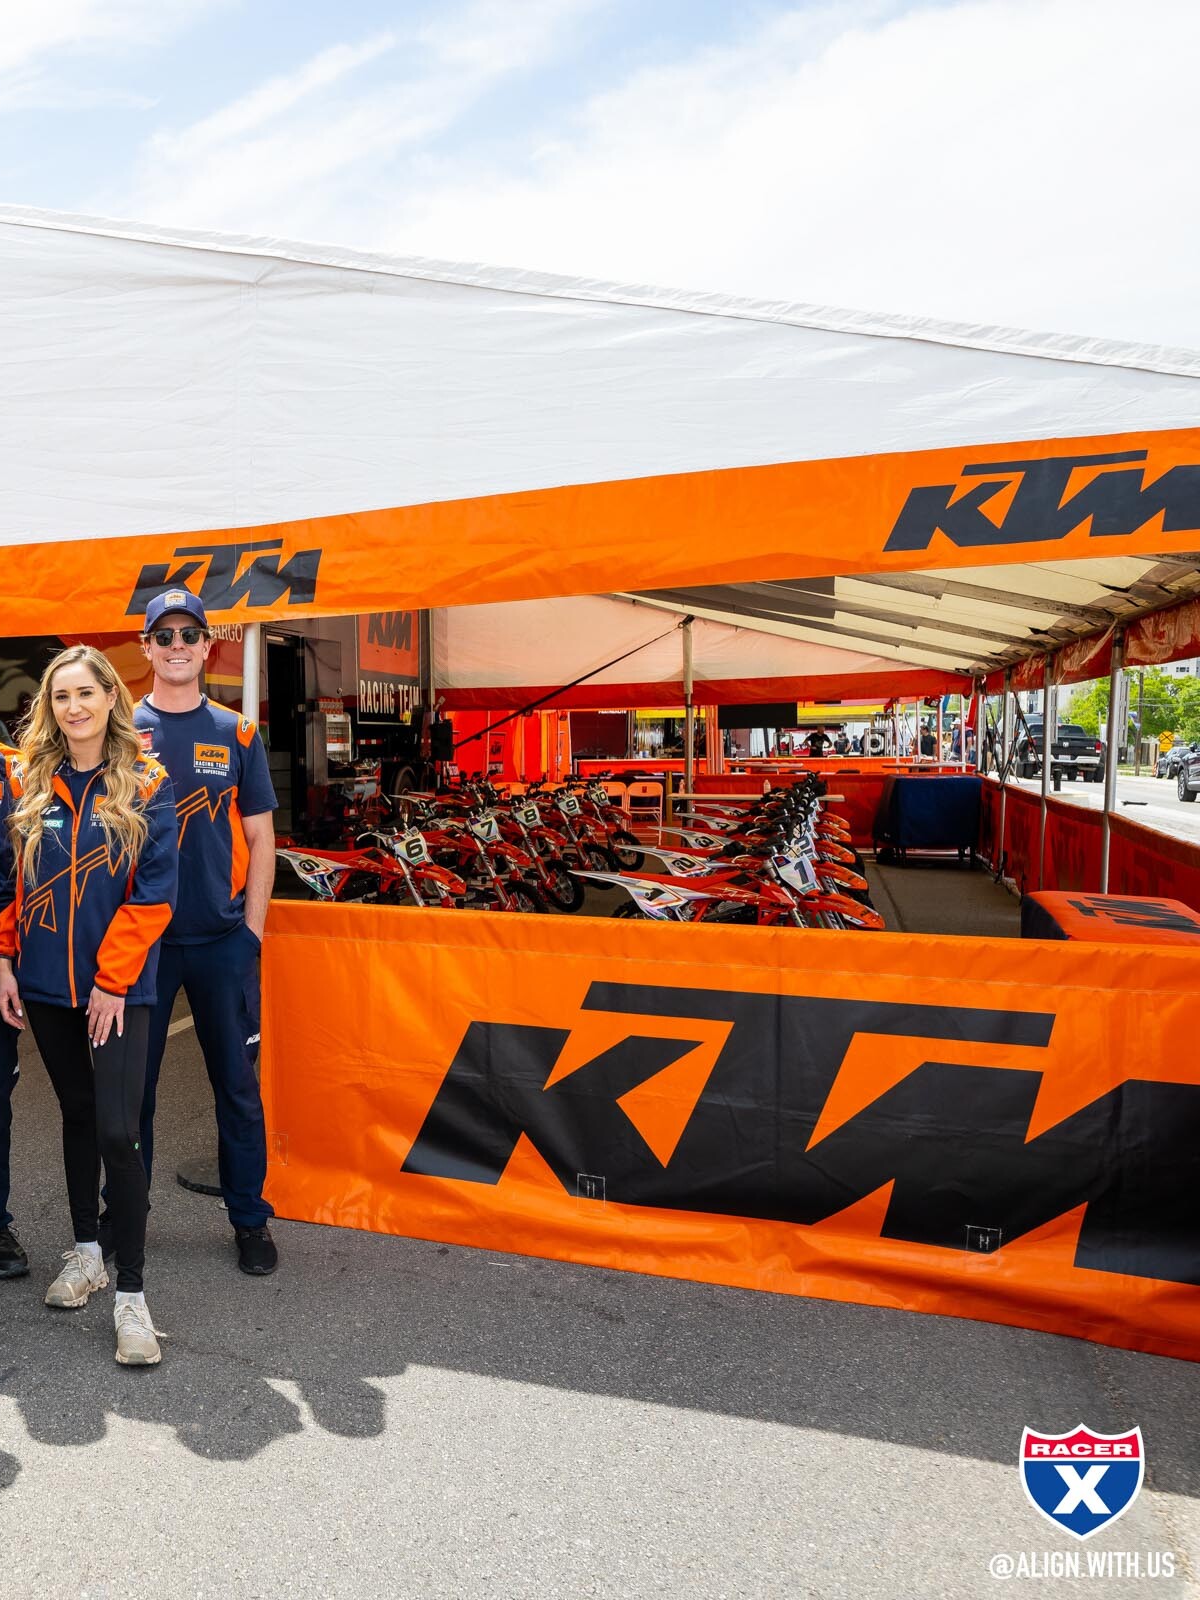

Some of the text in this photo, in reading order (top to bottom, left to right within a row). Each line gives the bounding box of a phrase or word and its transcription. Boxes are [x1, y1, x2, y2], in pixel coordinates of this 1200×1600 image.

[882, 449, 1200, 552] KTM
[125, 538, 322, 615] KTM
[211, 623, 243, 643] ARGO
[360, 680, 395, 714] RACING
[195, 760, 214, 768] RACING
[200, 749, 224, 759] KTM
[565, 799, 577, 812] 9
[595, 791, 607, 801] 10
[523, 808, 537, 823] 8
[481, 820, 493, 837] 7
[405, 837, 424, 859] 6
[793, 860, 810, 885] 1
[400, 980, 1200, 1286] KTM
